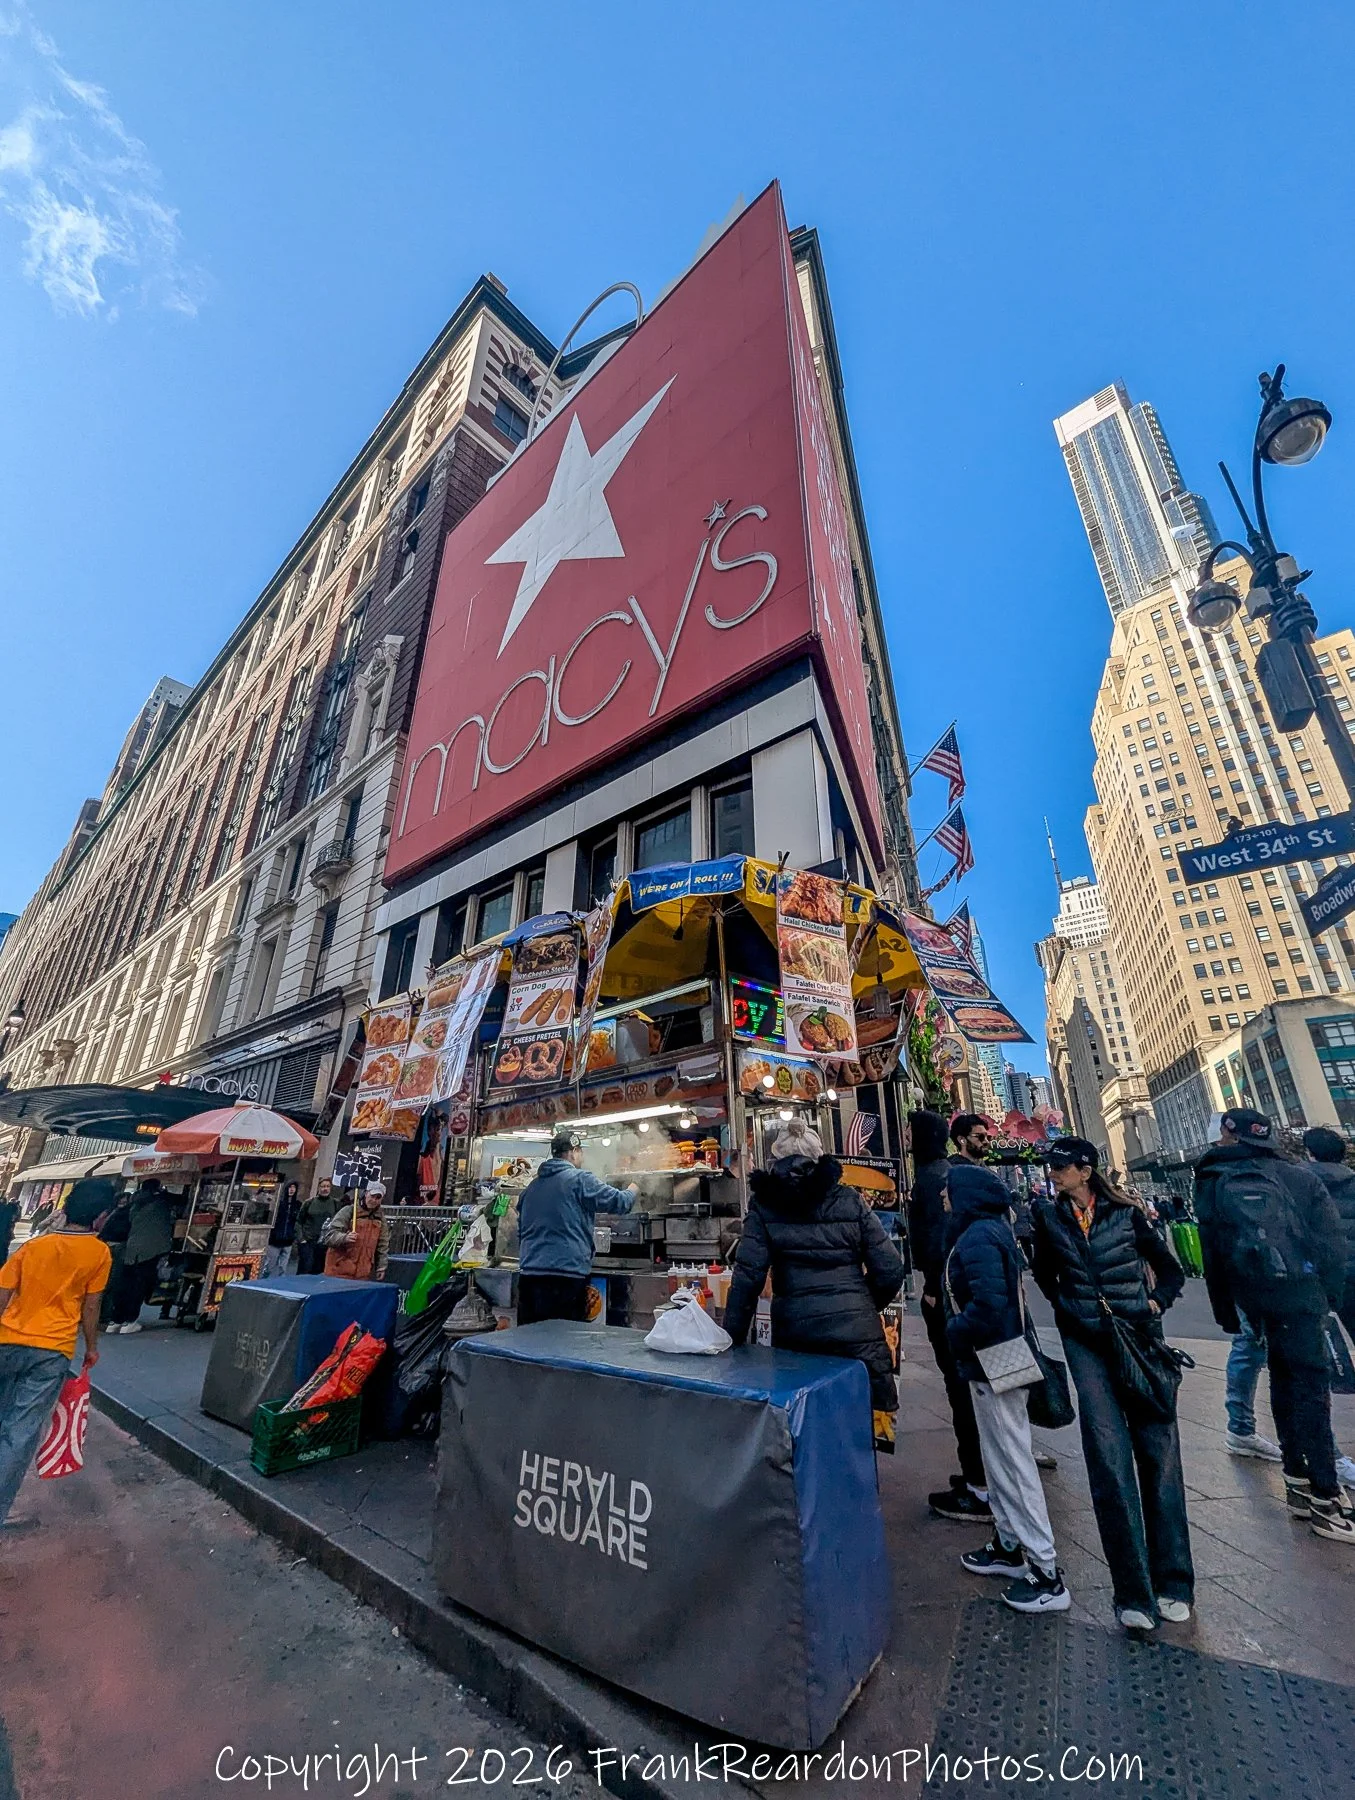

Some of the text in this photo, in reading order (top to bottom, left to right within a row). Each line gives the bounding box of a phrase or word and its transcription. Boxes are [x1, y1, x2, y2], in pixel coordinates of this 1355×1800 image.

[1234, 828, 1278, 844] 173 101
[1192, 828, 1337, 873] West 34th St
[670, 882, 683, 891] ON
[694, 874, 718, 884] ROLL
[784, 917, 841, 936] Halal Chicken Kebab
[528, 969, 550, 979] Cheese
[551, 965, 569, 974] Steak
[511, 982, 547, 995] Corn Dog
[795, 980, 816, 989] Falafel
[509, 1003, 524, 1012] NY
[787, 993, 841, 1009] Falafel Sandwich
[513, 1030, 562, 1045] CHEESE PRETZEL
[850, 1158, 869, 1166] Cheese
[869, 1160, 894, 1169] Sandwich
[231, 1234, 238, 1243] A
[883, 1307, 897, 1316] Fries
[758, 1330, 769, 1340] NY
[519, 1450, 652, 1524] HERALD
[513, 1489, 648, 1570] SQUARE
